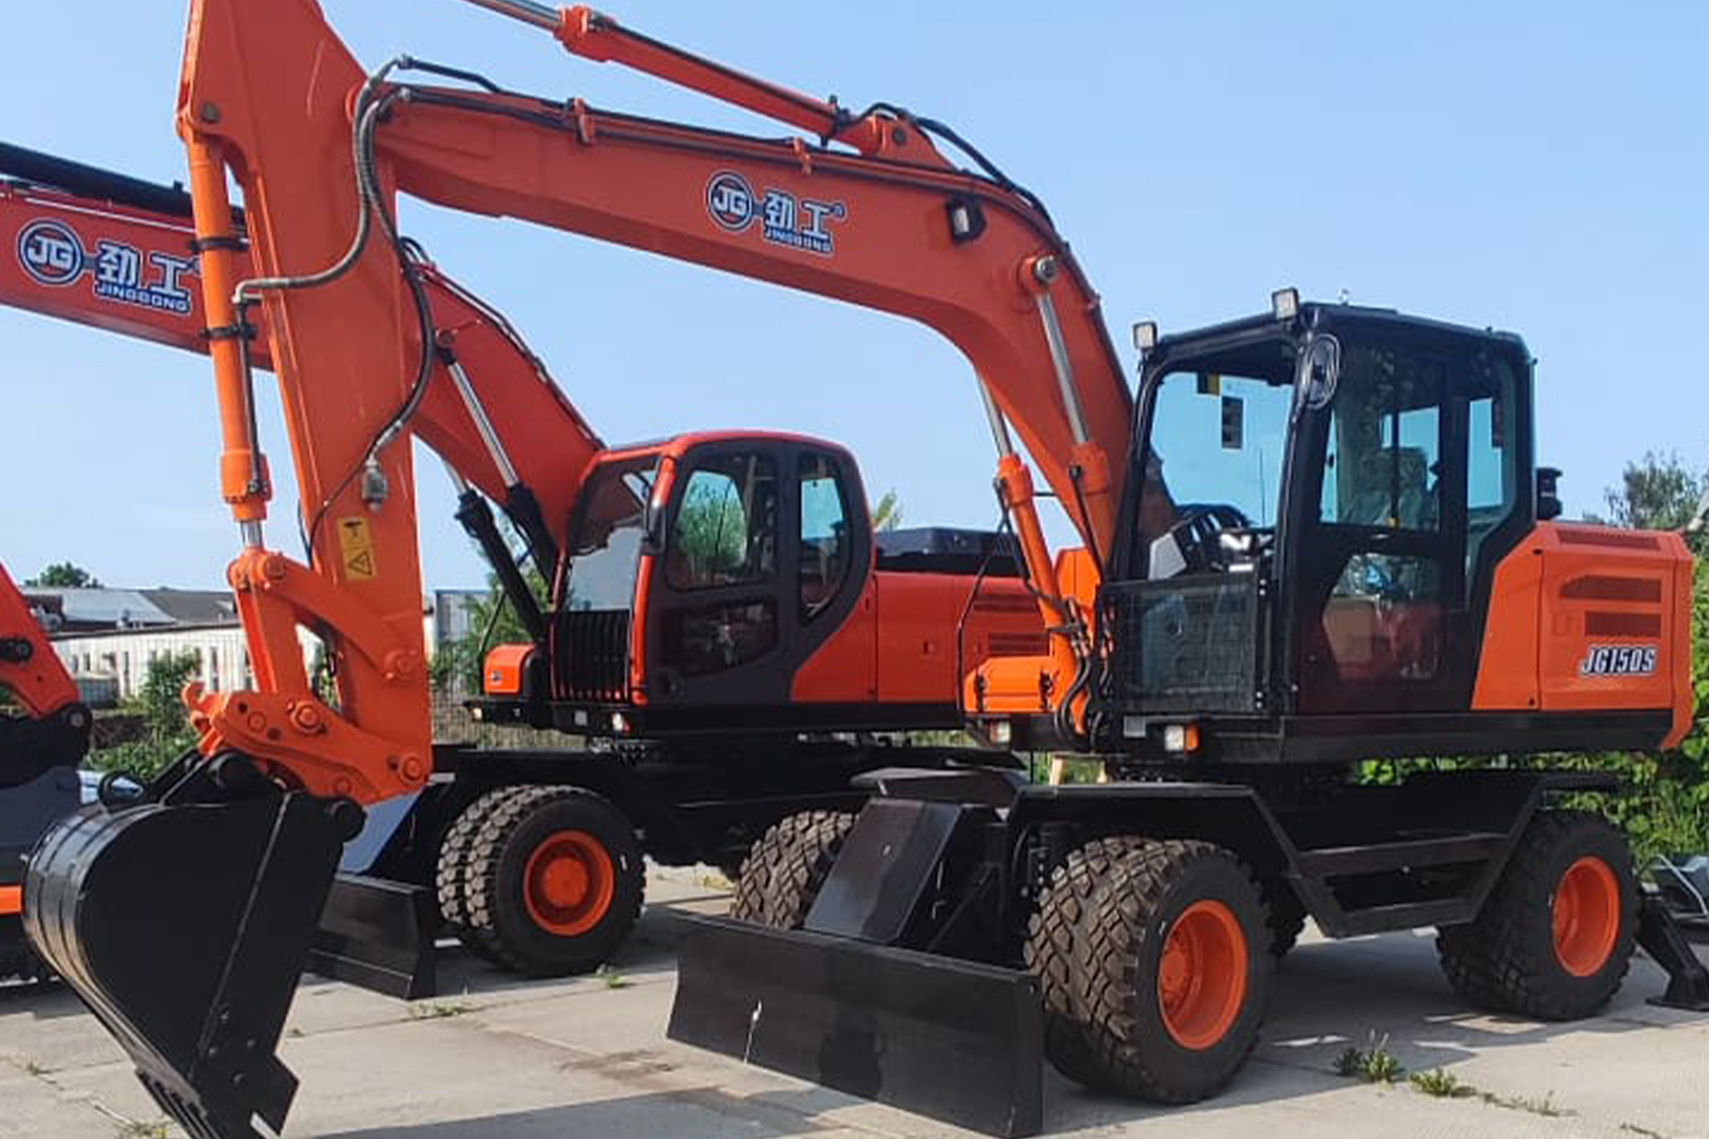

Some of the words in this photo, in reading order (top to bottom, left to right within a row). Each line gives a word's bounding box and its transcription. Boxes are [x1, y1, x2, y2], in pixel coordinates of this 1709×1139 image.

[714, 185, 748, 217] JG
[765, 192, 830, 239] 劲工
[26, 235, 75, 269] JG
[99, 243, 188, 299] 劲工
[96, 283, 189, 312] JINGGONG
[1581, 648, 1657, 673] JG150S
